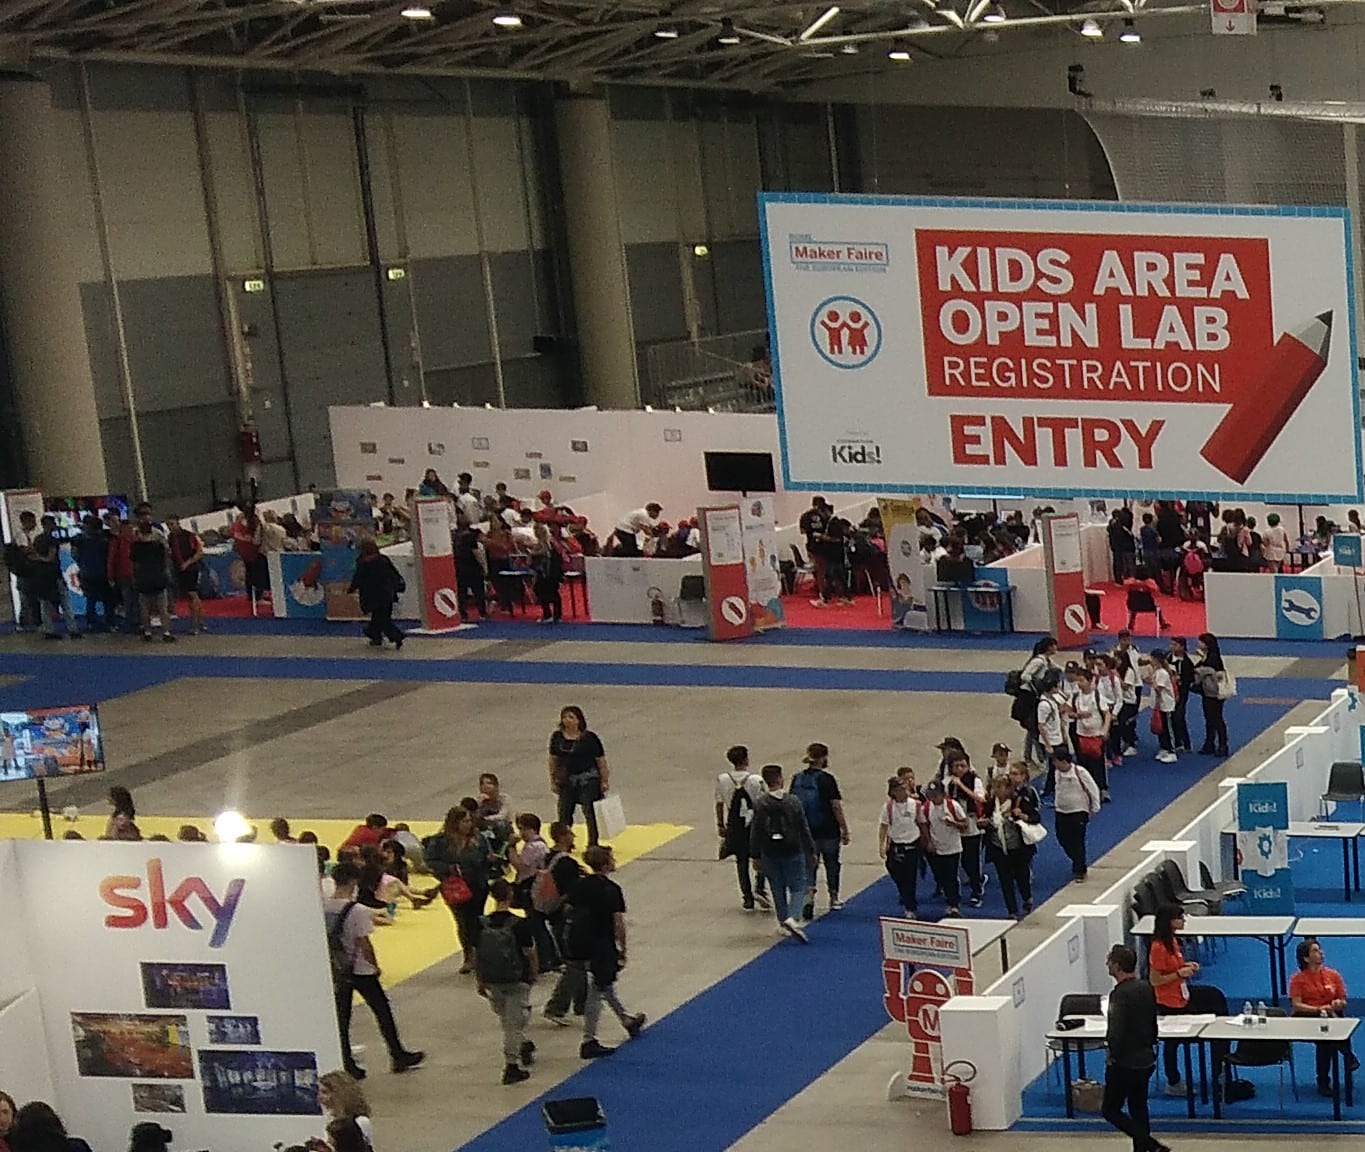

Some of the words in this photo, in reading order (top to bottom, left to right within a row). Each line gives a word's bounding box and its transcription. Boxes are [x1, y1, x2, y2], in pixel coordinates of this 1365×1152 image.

[794, 245, 841, 260] Maker
[846, 247, 884, 261] Faire
[935, 245, 1073, 295] KIDS
[1093, 250, 1250, 300] AREA
[938, 300, 1098, 348] OPEN
[1120, 305, 1229, 351] LAB
[944, 356, 1221, 393] REGISTRATION
[831, 445, 882, 463] Kids!
[950, 414, 1165, 470] ENTRY
[99, 857, 246, 949] sky
[895, 932, 927, 947] Maker
[930, 936, 956, 950] Faire
